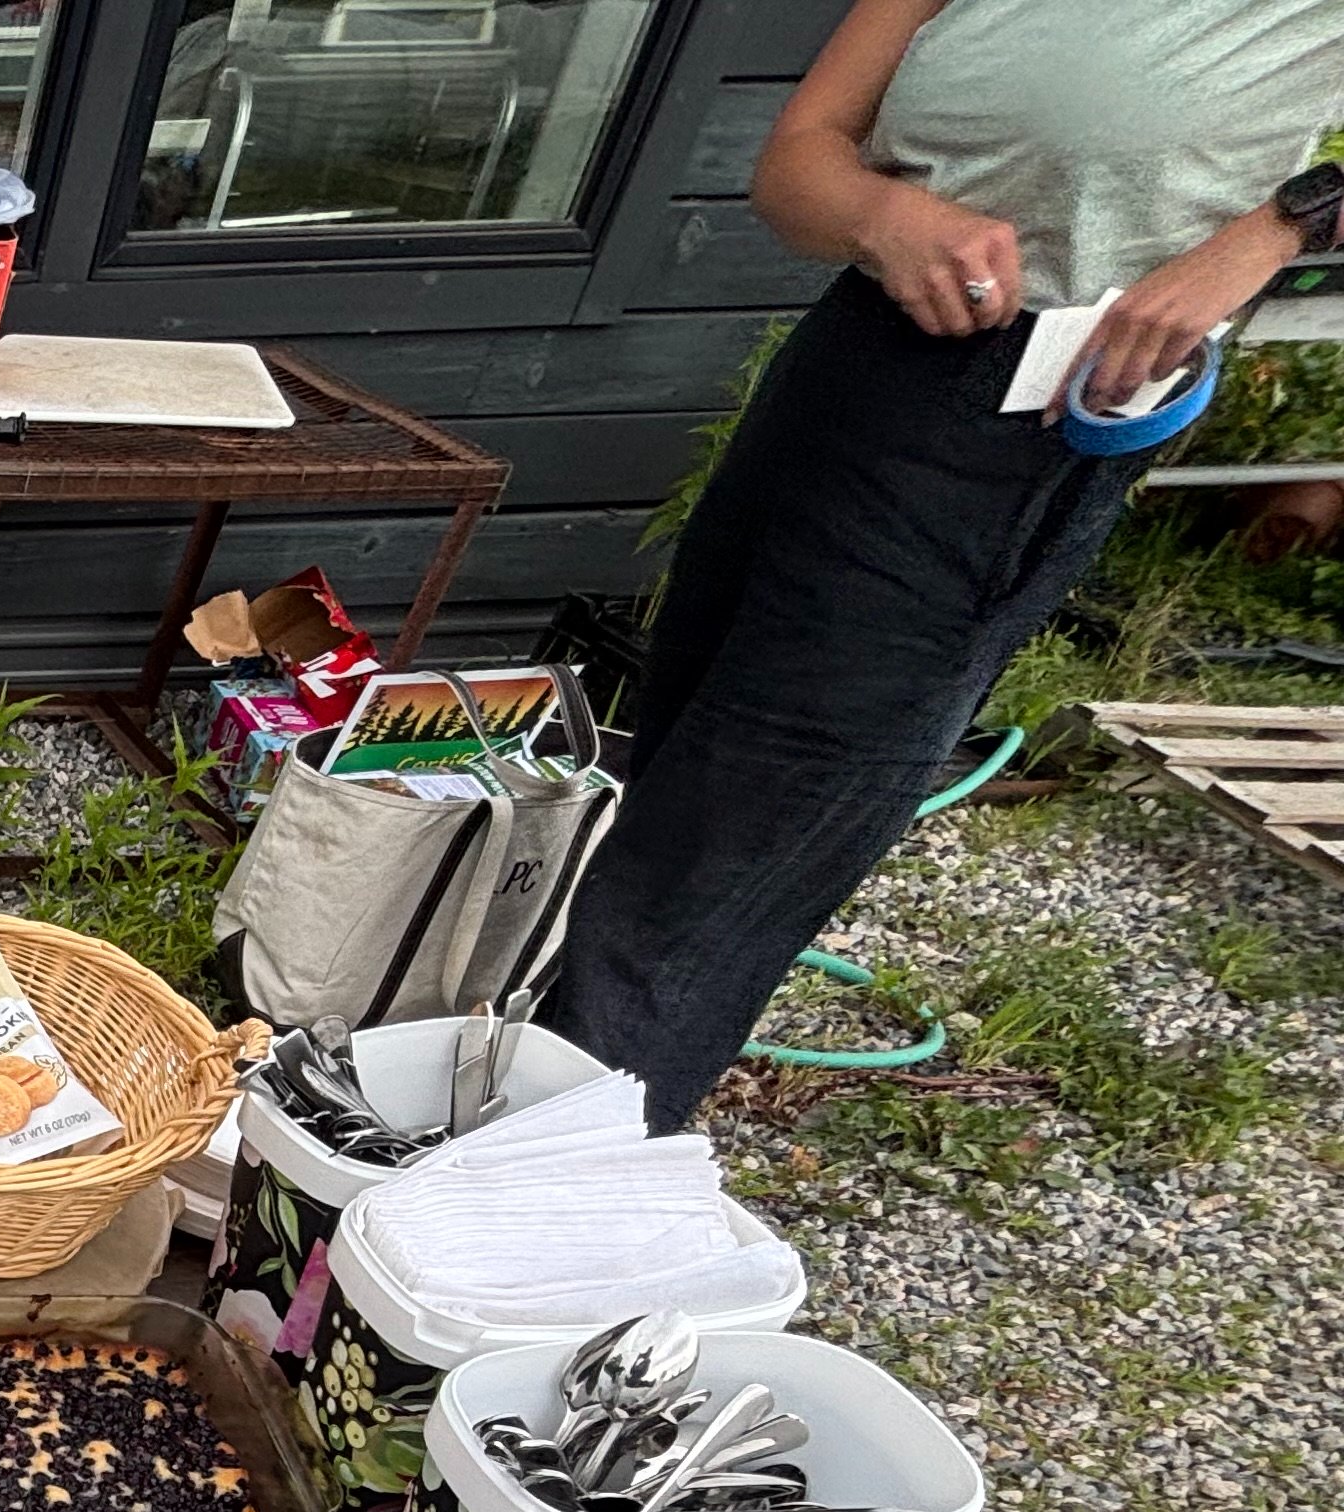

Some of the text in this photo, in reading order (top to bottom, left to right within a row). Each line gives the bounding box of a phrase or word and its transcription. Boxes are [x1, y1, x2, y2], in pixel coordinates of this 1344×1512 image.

[397, 751, 475, 771] Certif
[493, 860, 543, 894] PC
[9, 1132, 28, 1147] NET
